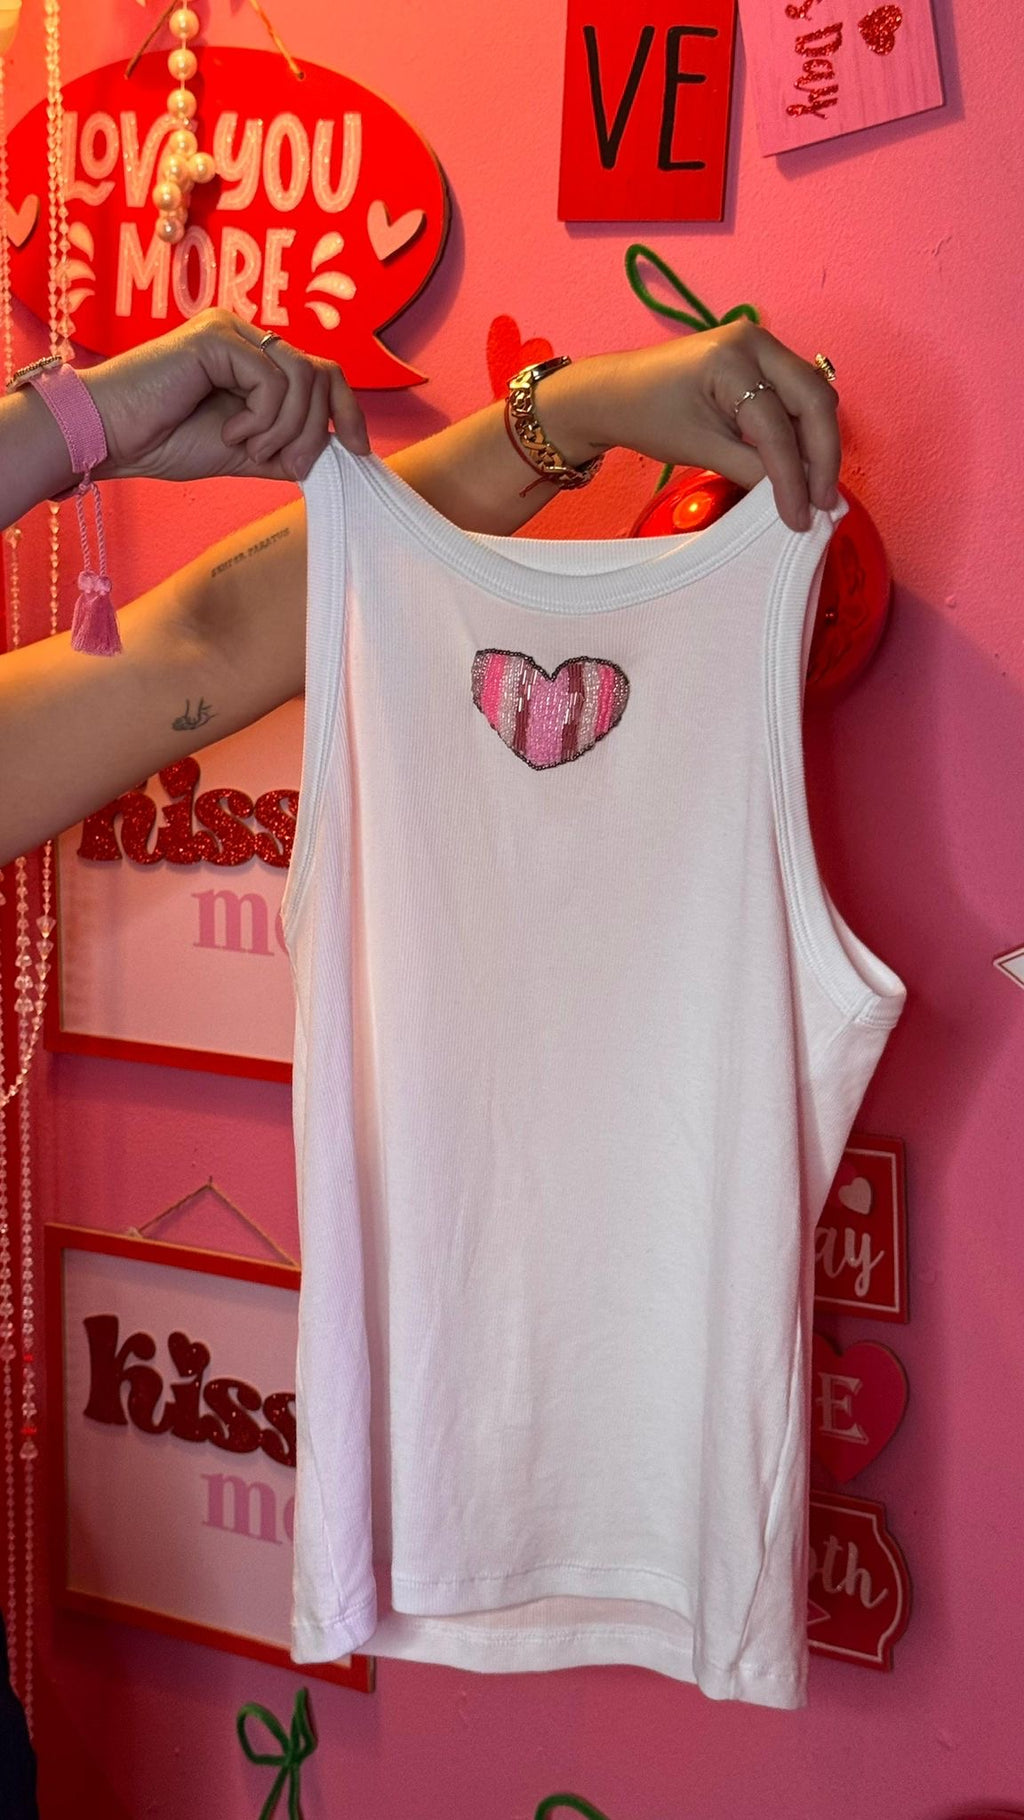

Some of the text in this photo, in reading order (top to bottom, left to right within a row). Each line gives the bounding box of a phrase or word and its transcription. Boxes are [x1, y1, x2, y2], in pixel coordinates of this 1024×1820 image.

[583, 25, 718, 171] VE
[786, 22, 843, 120] Day
[58, 111, 362, 212] LOV YOU
[115, 222, 296, 327] MORE
[191, 889, 289, 956] m
[83, 1314, 297, 1468] kiss
[201, 1473, 296, 1545] m
